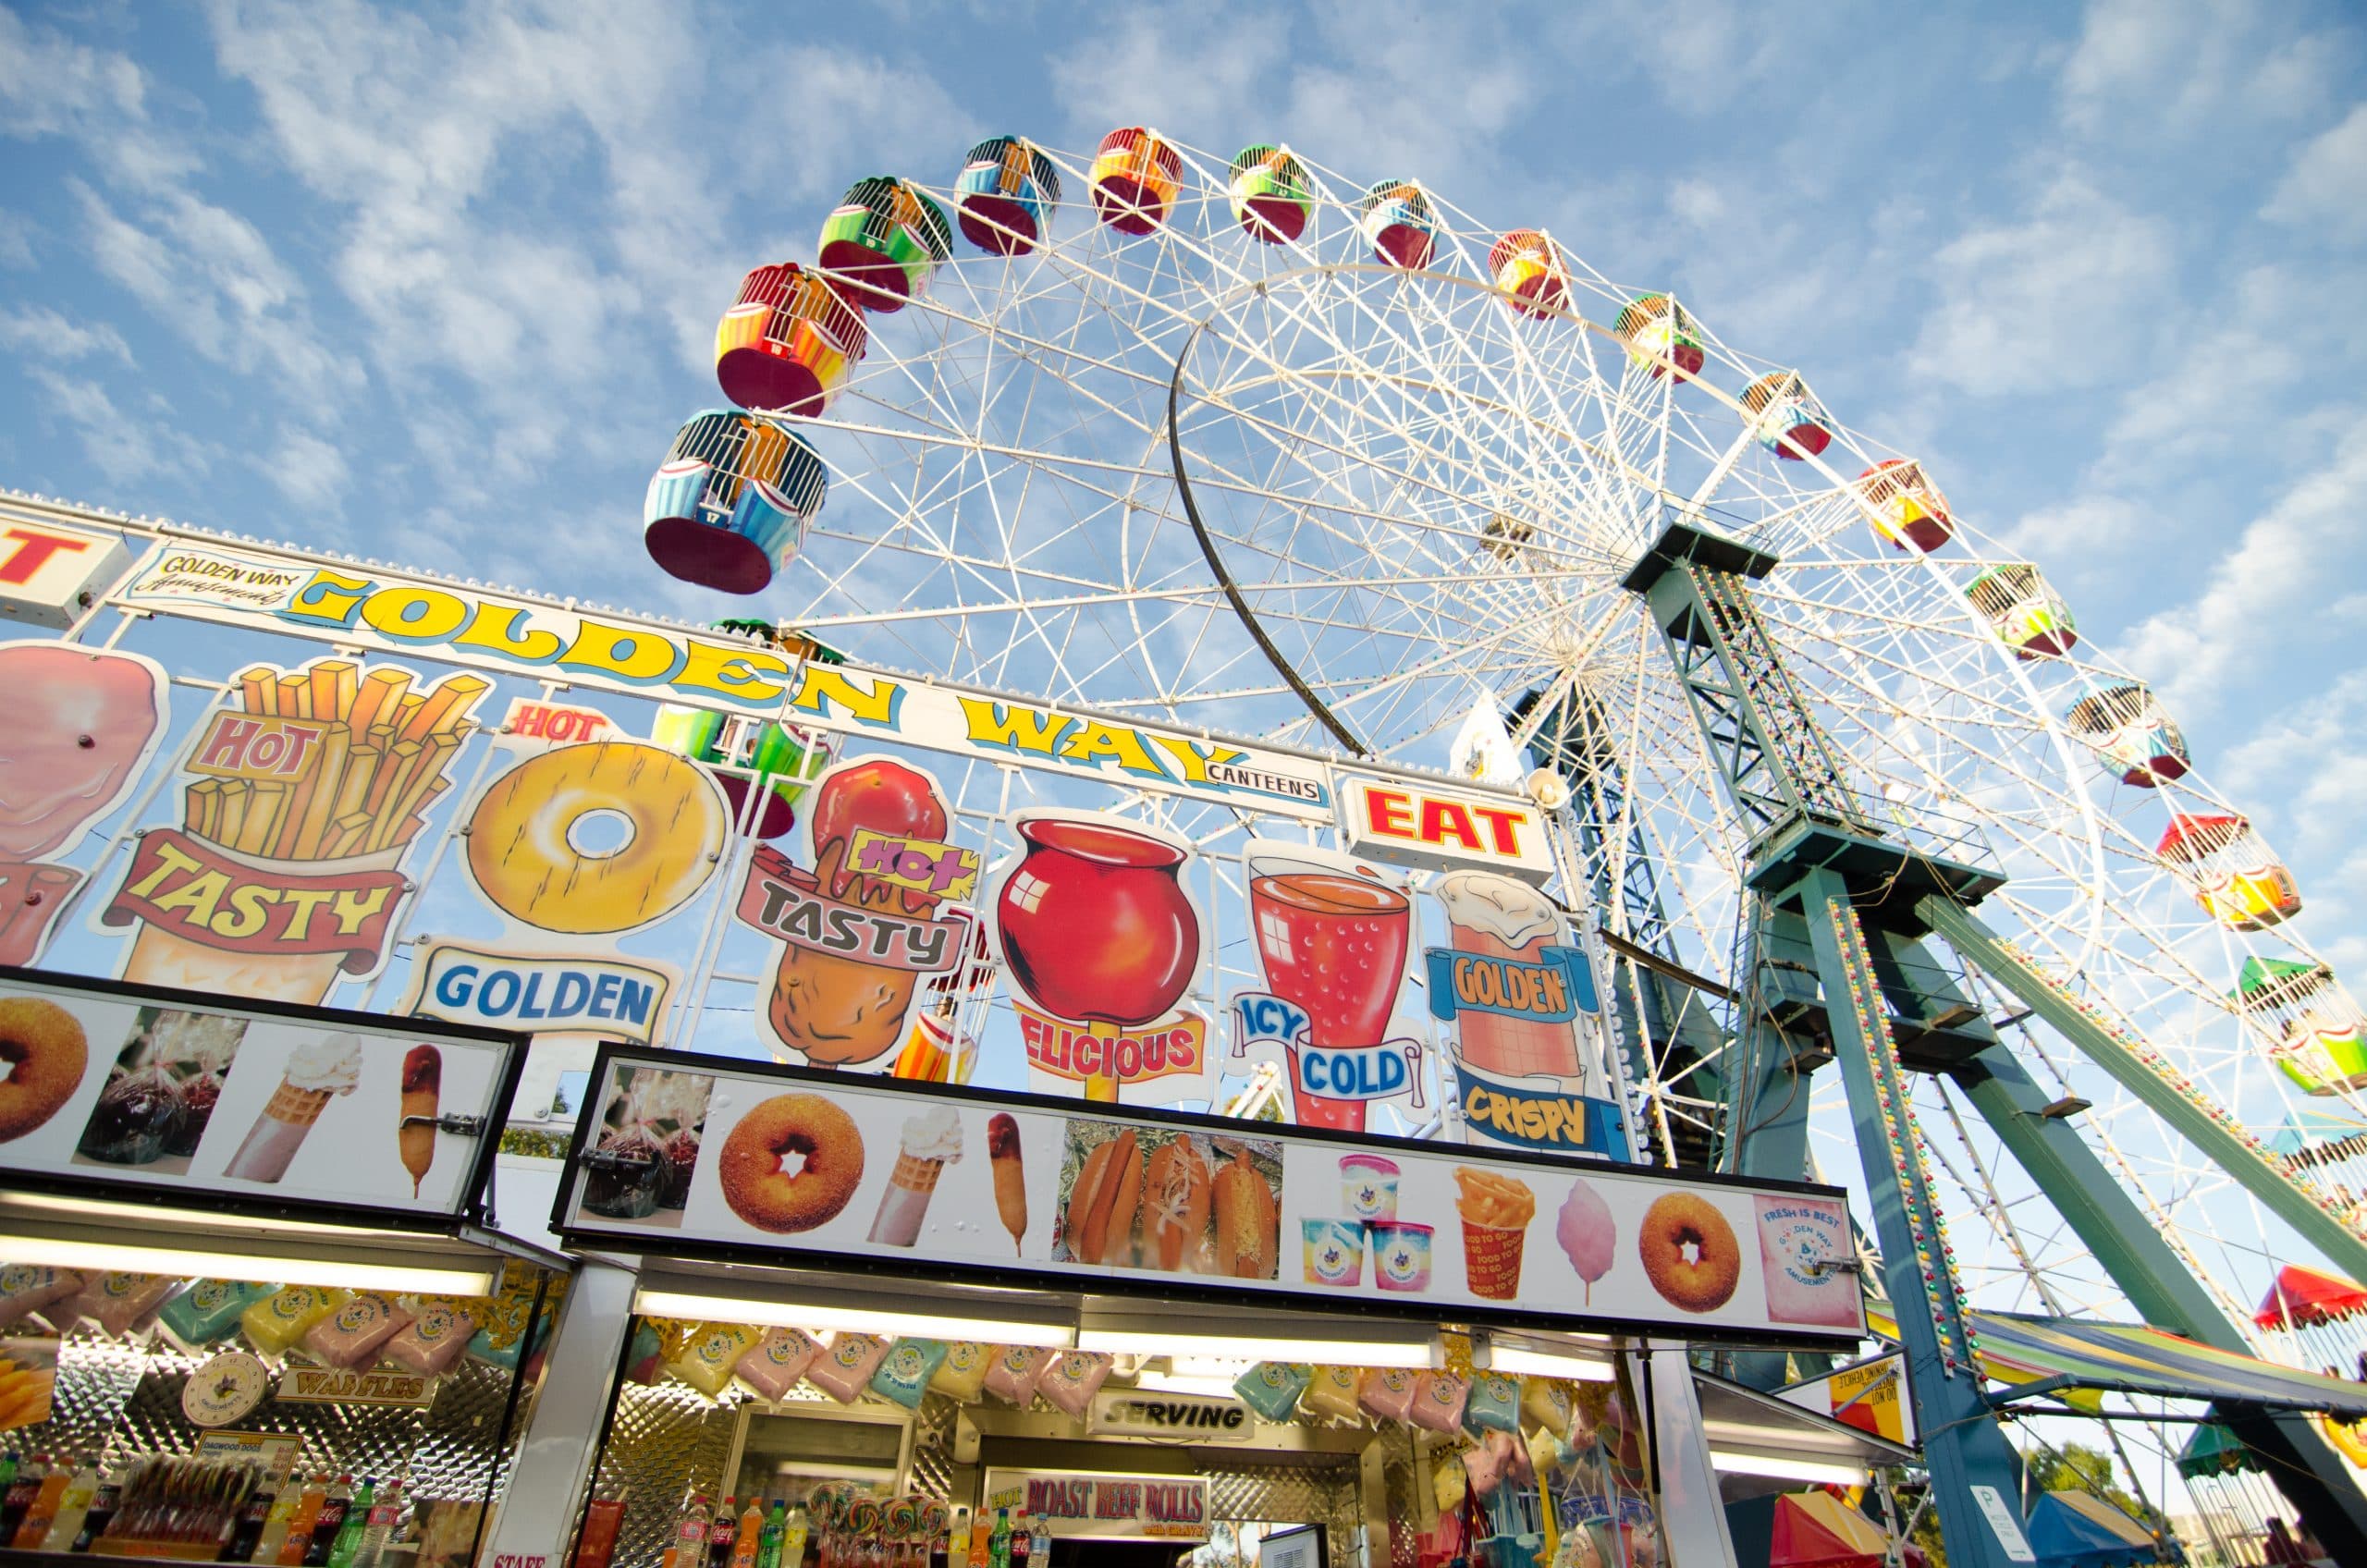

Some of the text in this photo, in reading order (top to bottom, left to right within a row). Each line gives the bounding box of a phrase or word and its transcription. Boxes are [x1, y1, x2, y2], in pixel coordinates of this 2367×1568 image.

[705, 512, 720, 525] 17
[136, 574, 288, 606] Amusements
[163, 556, 300, 586] GOLDEN WAY
[279, 568, 1246, 788] GOLDEN WAY
[511, 704, 607, 742] HOT
[199, 716, 325, 776] HOT
[1208, 764, 1319, 800] CANTEENS
[1364, 786, 1527, 859] EAT
[858, 839, 976, 892] HOT
[124, 840, 395, 943] TASTY
[761, 879, 948, 966] TASTY
[435, 964, 656, 1027] GOLDEN
[1454, 957, 1569, 1015] GOLDEN
[1240, 998, 1305, 1041] ICY
[1303, 1051, 1405, 1095] COLD
[1465, 1084, 1587, 1145] CRISPY
[1764, 1207, 1840, 1229] FRESH IS BEST
[1816, 1231, 1833, 1249] WAY
[1784, 1267, 1836, 1286] AMUSEMENTS
[1104, 1399, 1245, 1429] SERVING
[1871, 1388, 1896, 1406] DO NOT
[990, 1478, 1204, 1524] HOT ROAST BEEF ROLLS
